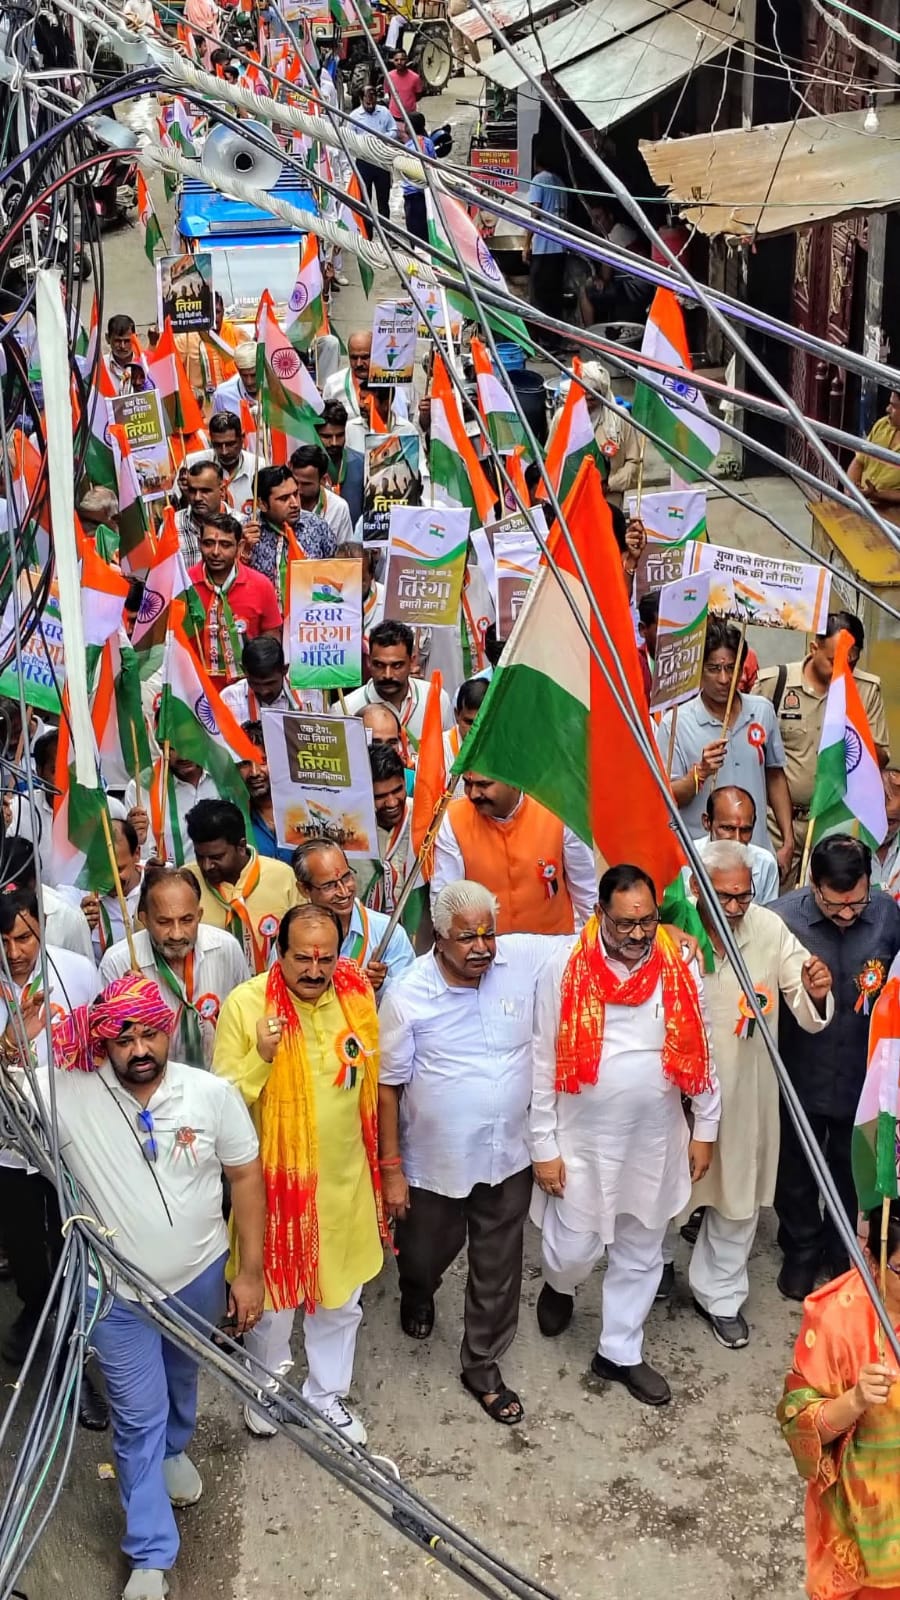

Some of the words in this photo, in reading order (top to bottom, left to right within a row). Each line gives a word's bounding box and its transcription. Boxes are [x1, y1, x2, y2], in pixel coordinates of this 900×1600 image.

[175, 299, 202, 312] तिरंगा
[125, 420, 155, 438] तिरंगा
[717, 550, 734, 561] युवा
[736, 554, 751, 565] चले
[754, 557, 779, 569] तिरंगा
[714, 559, 748, 576] देशभक्ति
[751, 568, 763, 579] की
[766, 571, 778, 582] लौ
[781, 573, 803, 585] लिए।
[398, 575, 451, 598] तिरंगा
[400, 599, 421, 609] हमारी
[423, 601, 439, 609] जान
[305, 609, 321, 622] हर
[325, 608, 343, 621] घर
[299, 622, 351, 643] तिरंगा
[301, 649, 345, 666] भारत
[658, 644, 701, 677] तिरंगा
[300, 724, 314, 733] एक
[297, 733, 311, 741] एक
[312, 733, 337, 744] निशान
[318, 743, 329, 751] घर
[297, 751, 341, 772] तिरंगा
[297, 771, 315, 779] हमारा
